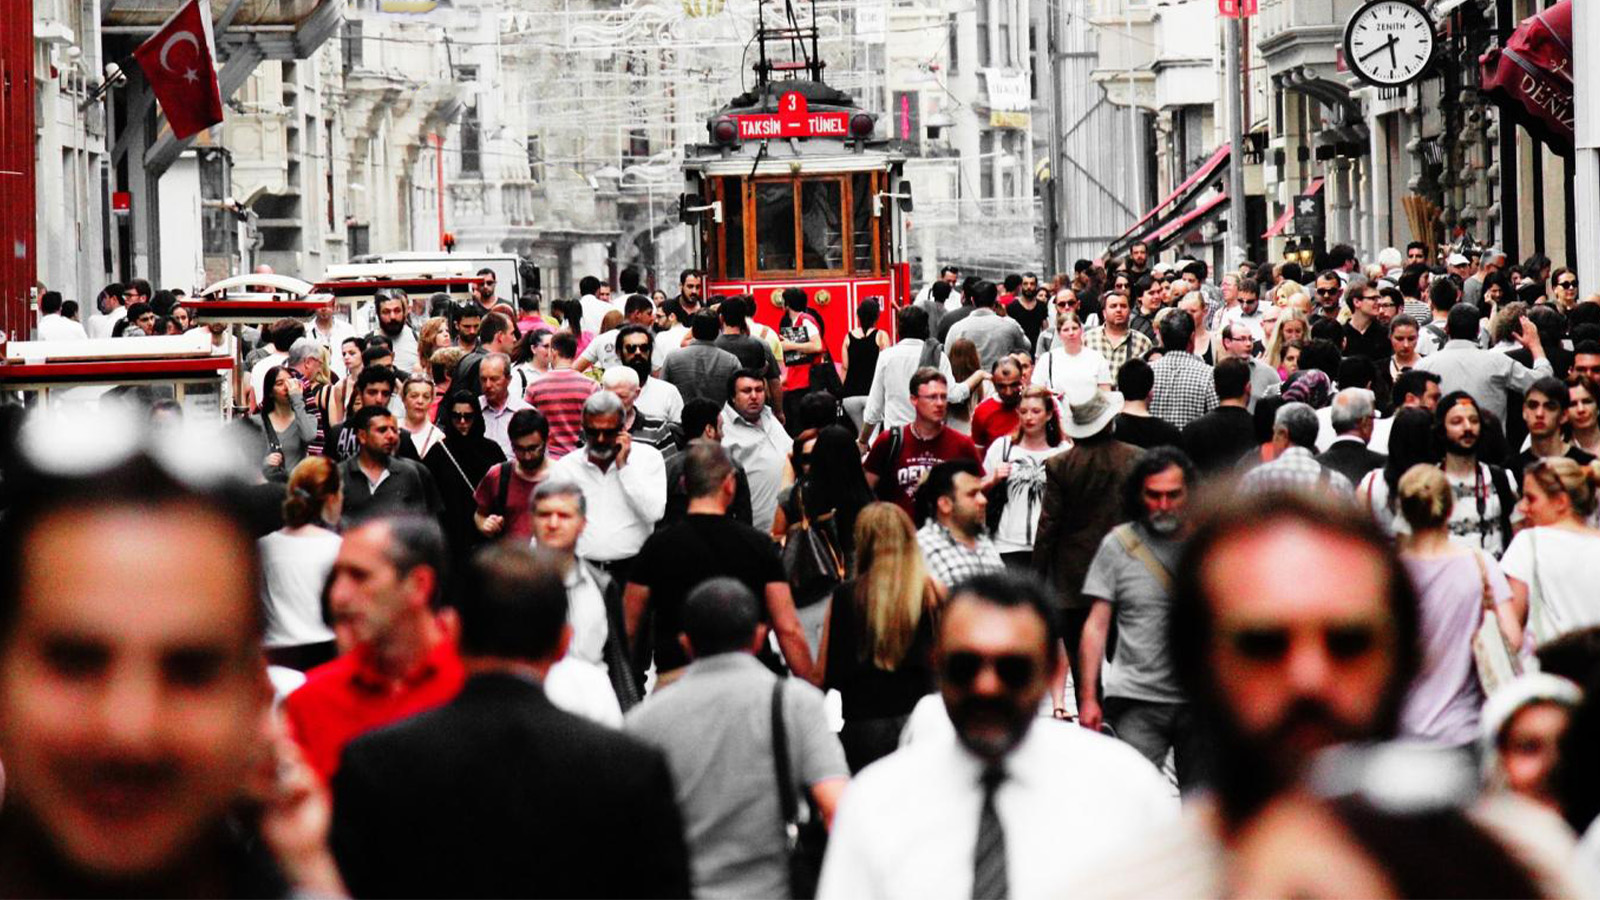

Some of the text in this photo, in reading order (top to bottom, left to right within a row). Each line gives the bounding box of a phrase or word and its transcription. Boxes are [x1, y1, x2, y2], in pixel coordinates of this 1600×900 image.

[1376, 23, 1406, 31] ZENITH
[787, 94, 797, 111] 3
[807, 116, 846, 133] TÜNEL
